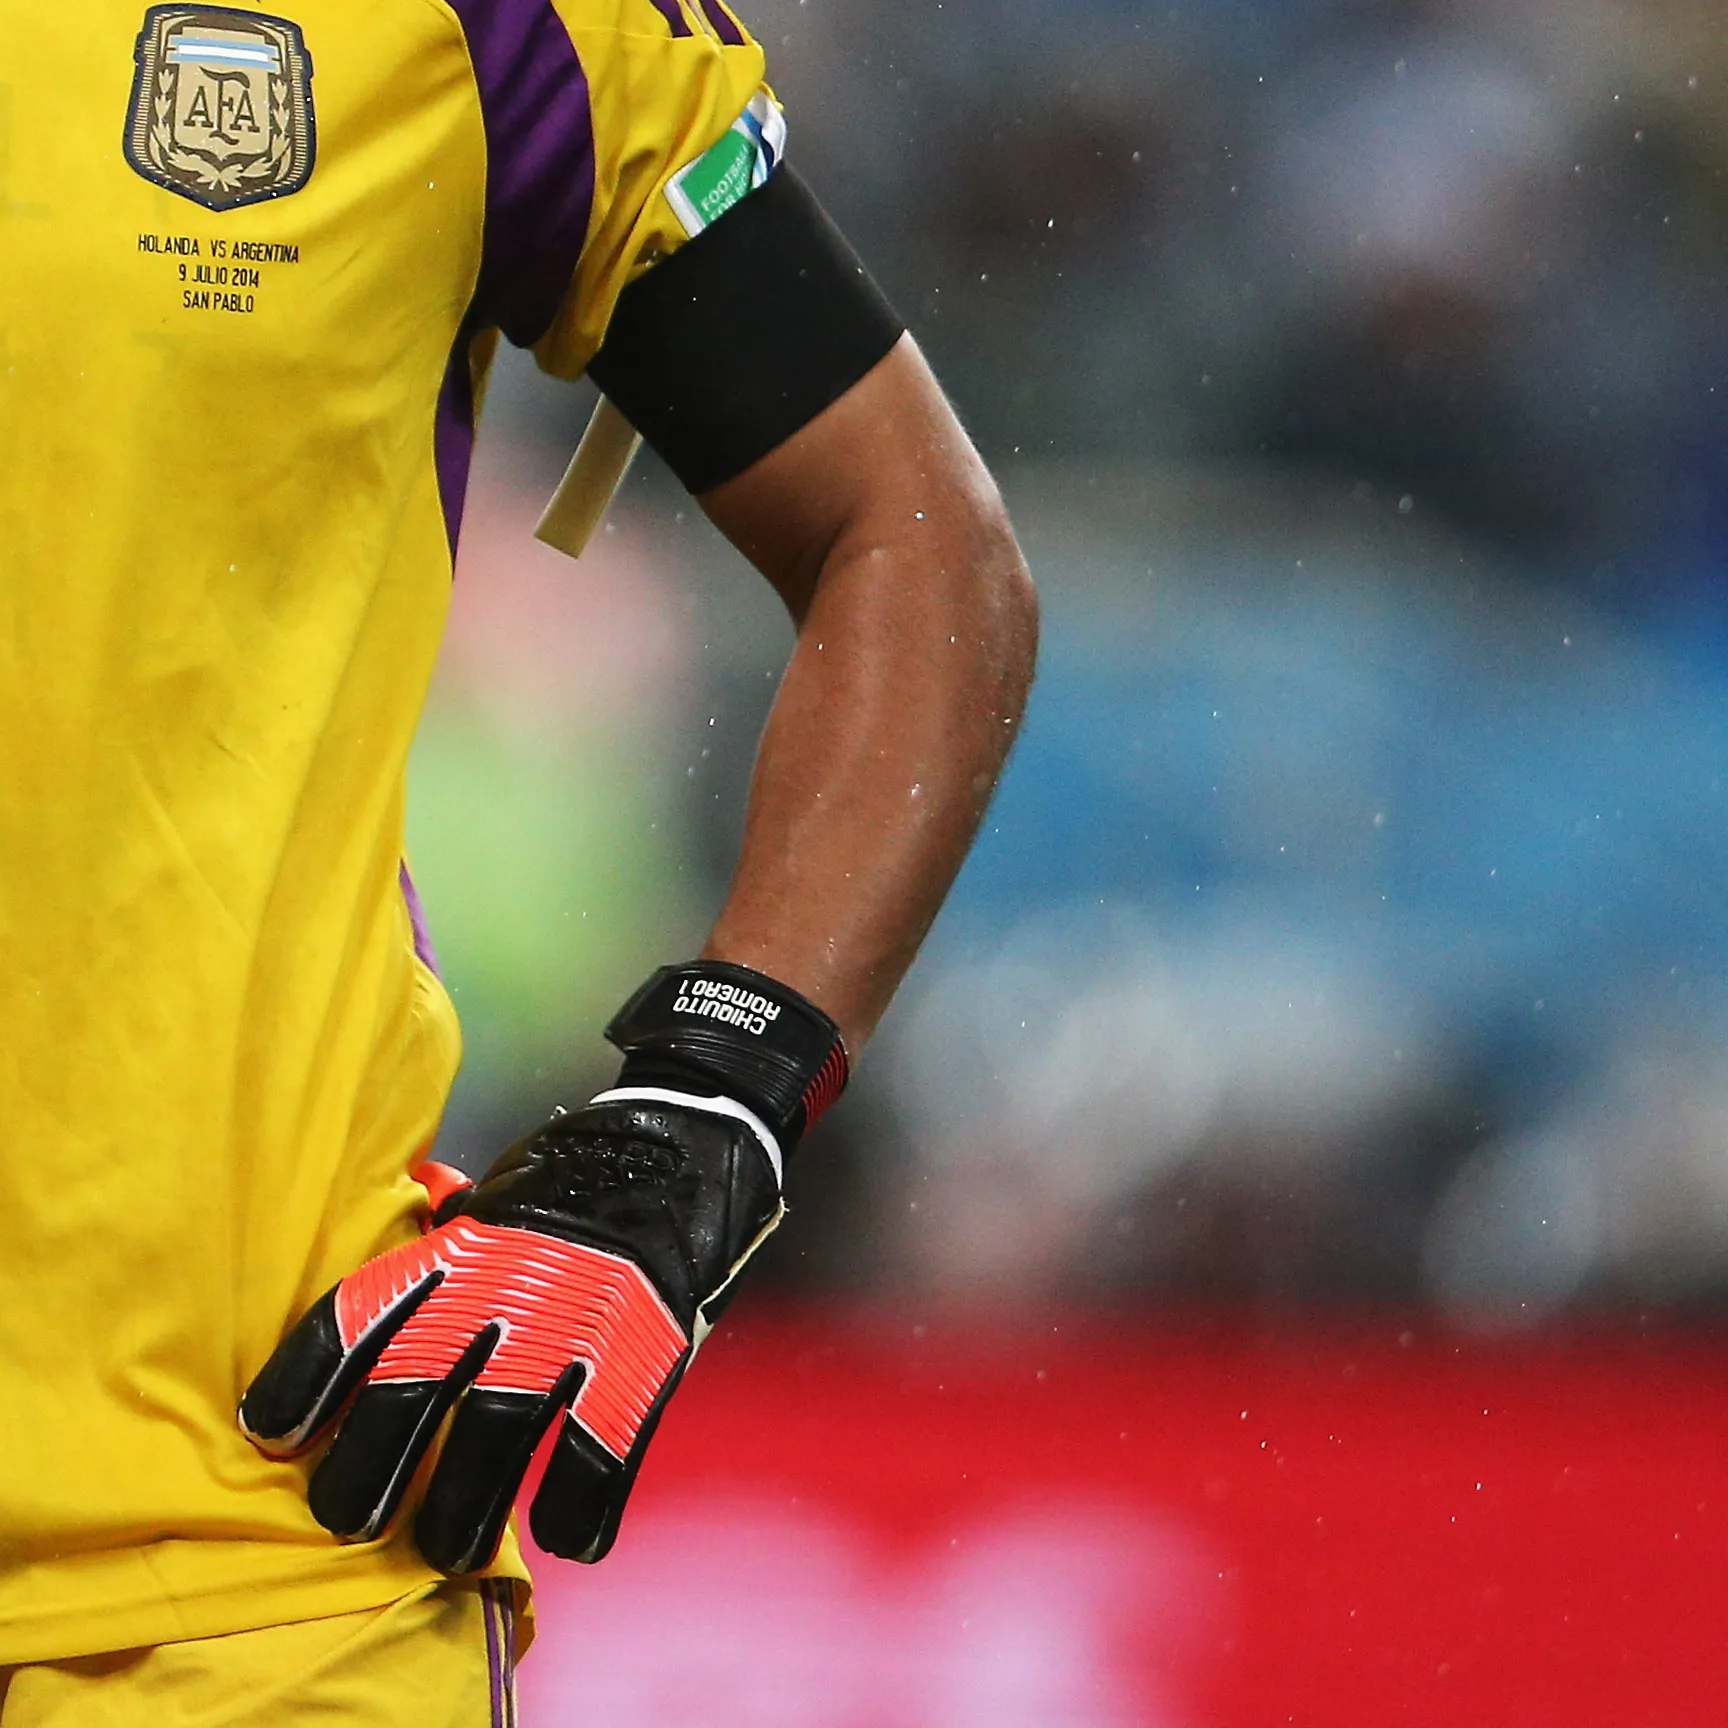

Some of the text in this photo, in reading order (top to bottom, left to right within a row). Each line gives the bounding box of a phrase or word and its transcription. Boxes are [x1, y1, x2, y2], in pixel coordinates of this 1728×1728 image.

[183, 65, 260, 146] AFA
[138, 234, 299, 263] HOLANDA VS ARGENTINA
[178, 263, 259, 288] 9 JULIO 2014
[183, 290, 254, 313] SAN PABLO
[672, 996, 767, 1035] CHIQUITO
[678, 979, 781, 1021] ROMERO 1
